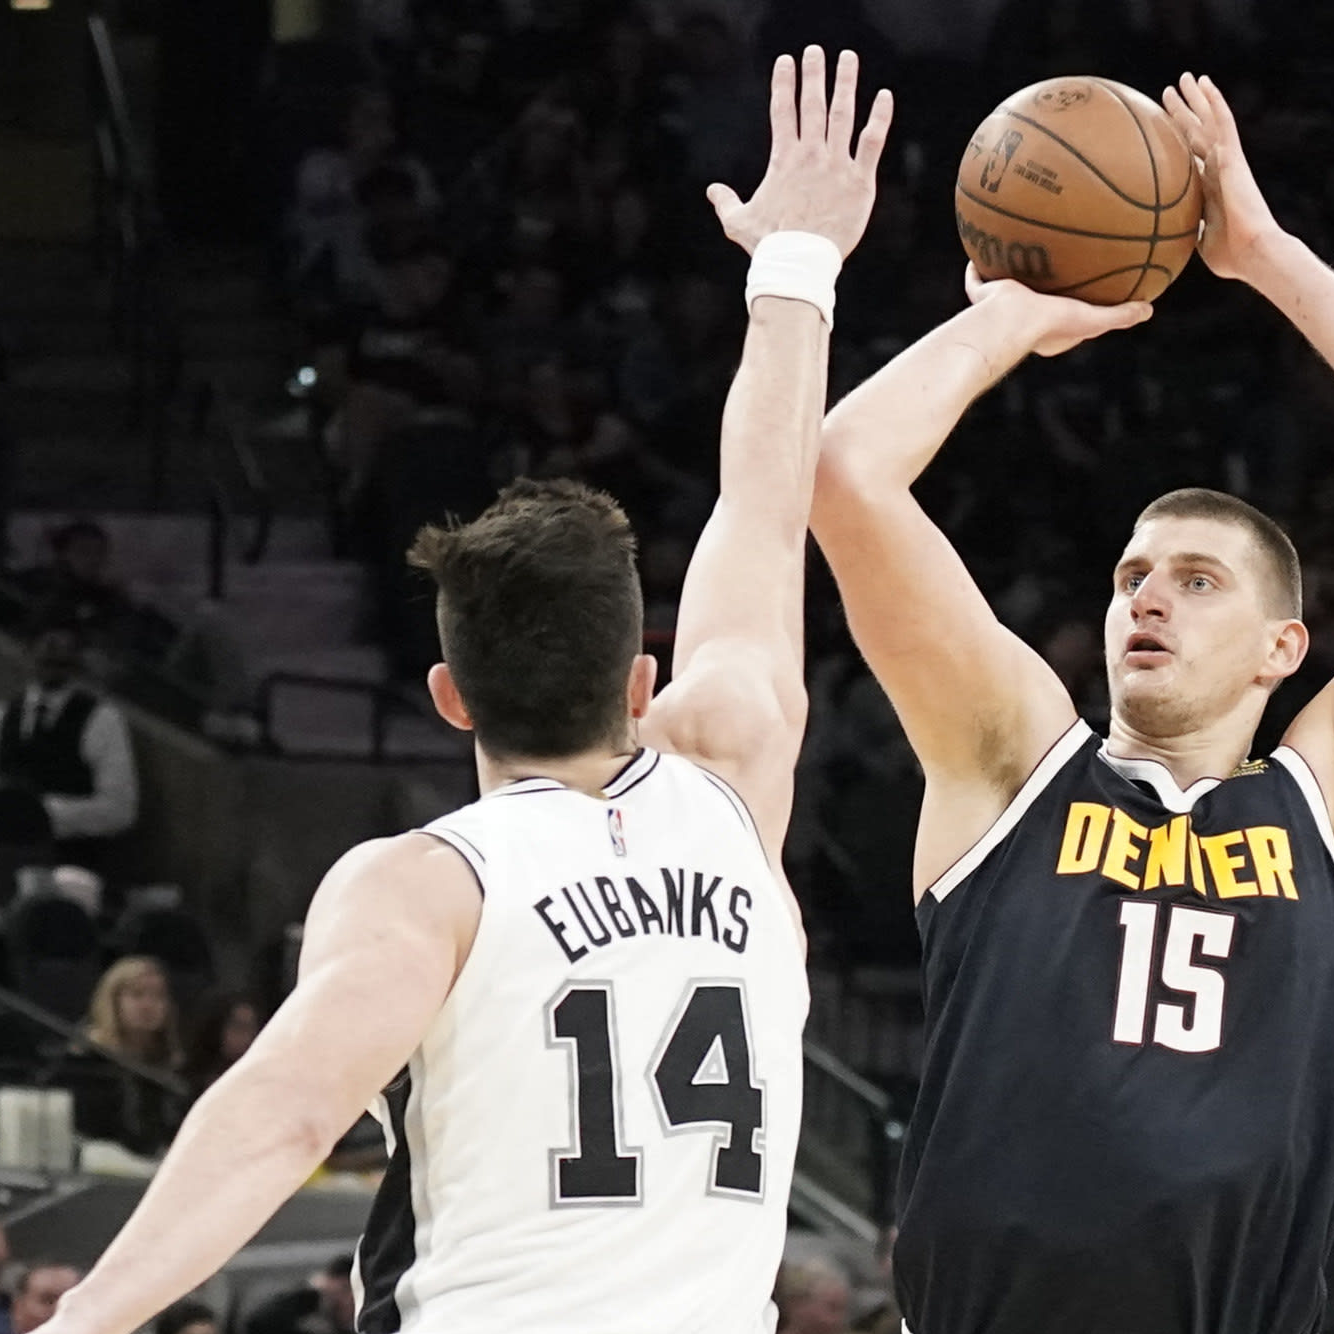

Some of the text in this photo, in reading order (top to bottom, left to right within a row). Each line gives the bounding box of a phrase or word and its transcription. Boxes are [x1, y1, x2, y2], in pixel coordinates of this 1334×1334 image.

[533, 867, 753, 964] EUBANKS
[1113, 899, 1236, 1054] 15
[544, 976, 768, 1210] 14
